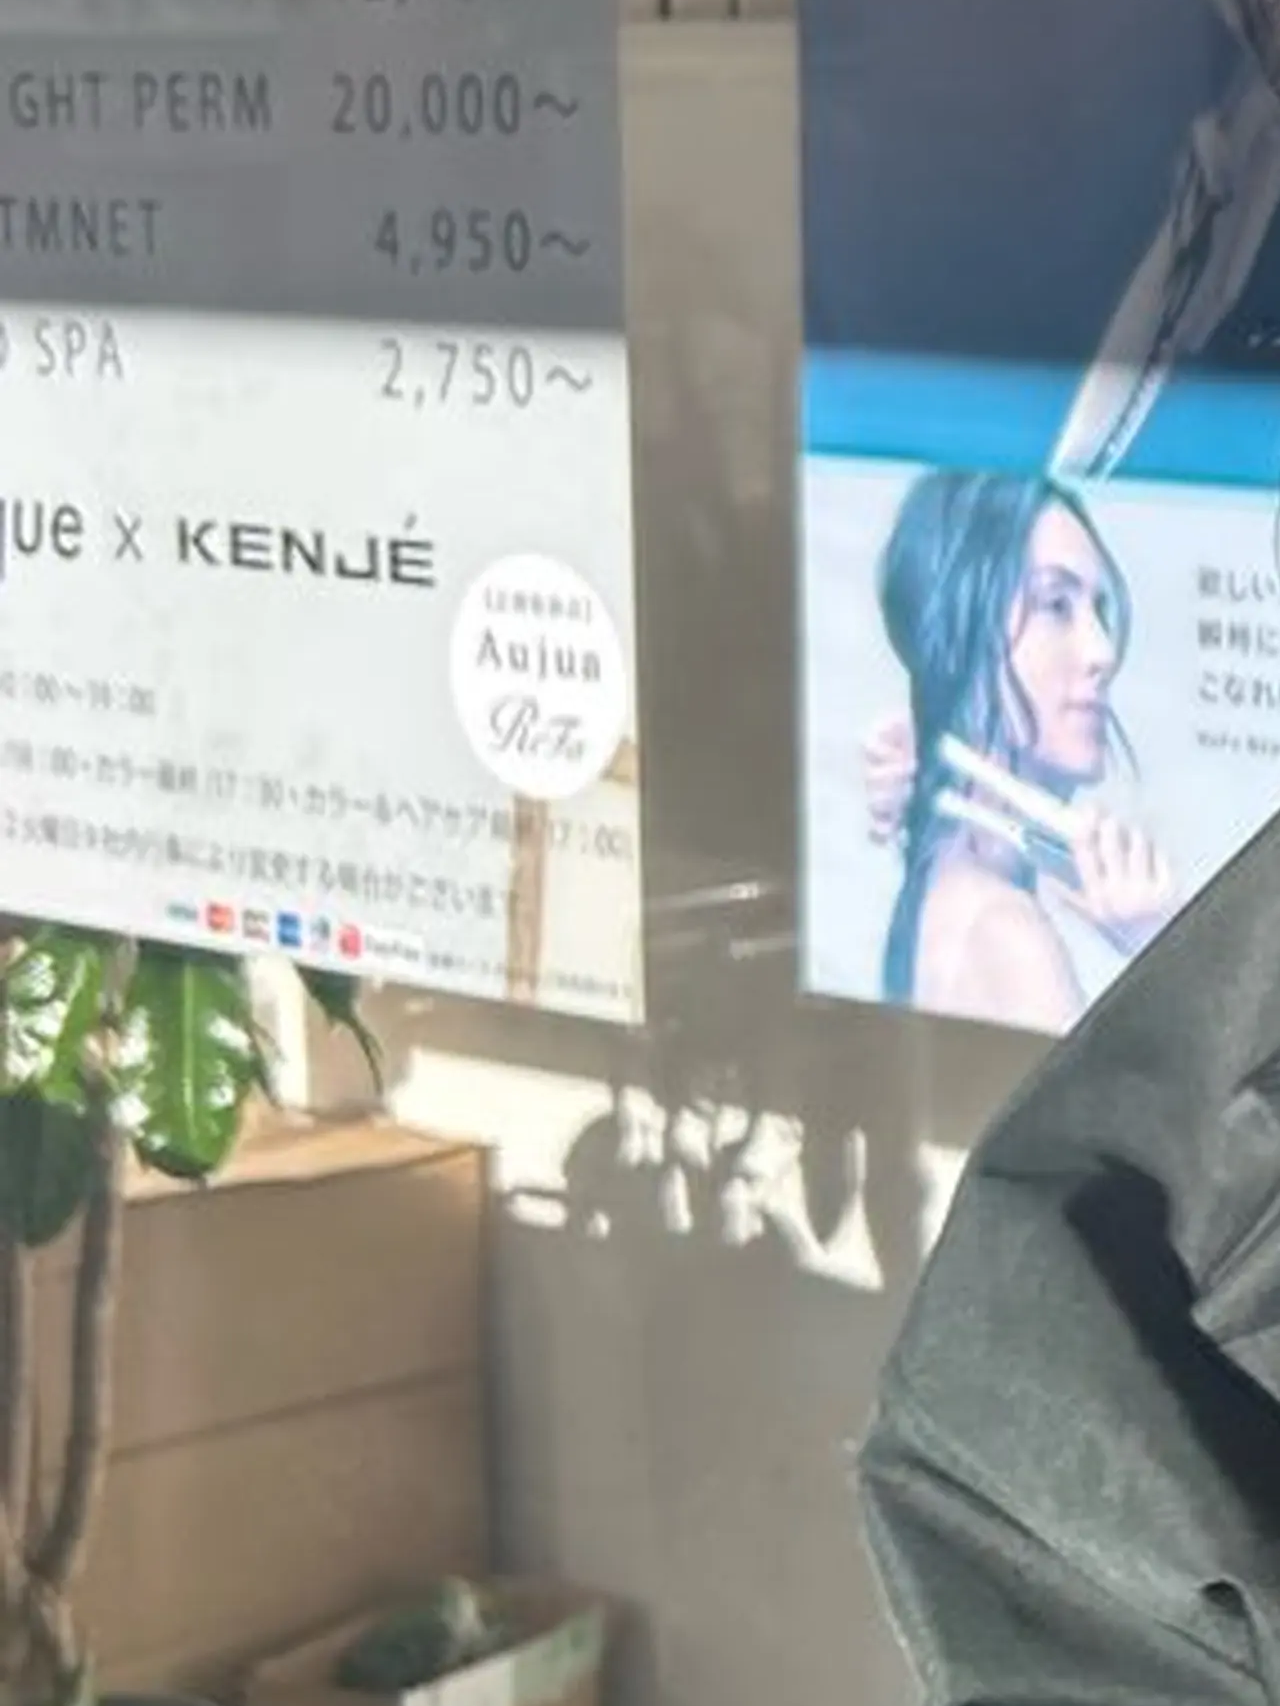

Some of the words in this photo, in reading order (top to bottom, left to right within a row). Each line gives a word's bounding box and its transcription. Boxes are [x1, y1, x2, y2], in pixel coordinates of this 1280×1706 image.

[8, 70, 108, 131] GHT
[132, 70, 273, 133] PERM
[0, 197, 164, 257] TMNET
[34, 317, 124, 379] SPA
[176, 513, 438, 589] KENJÉ
